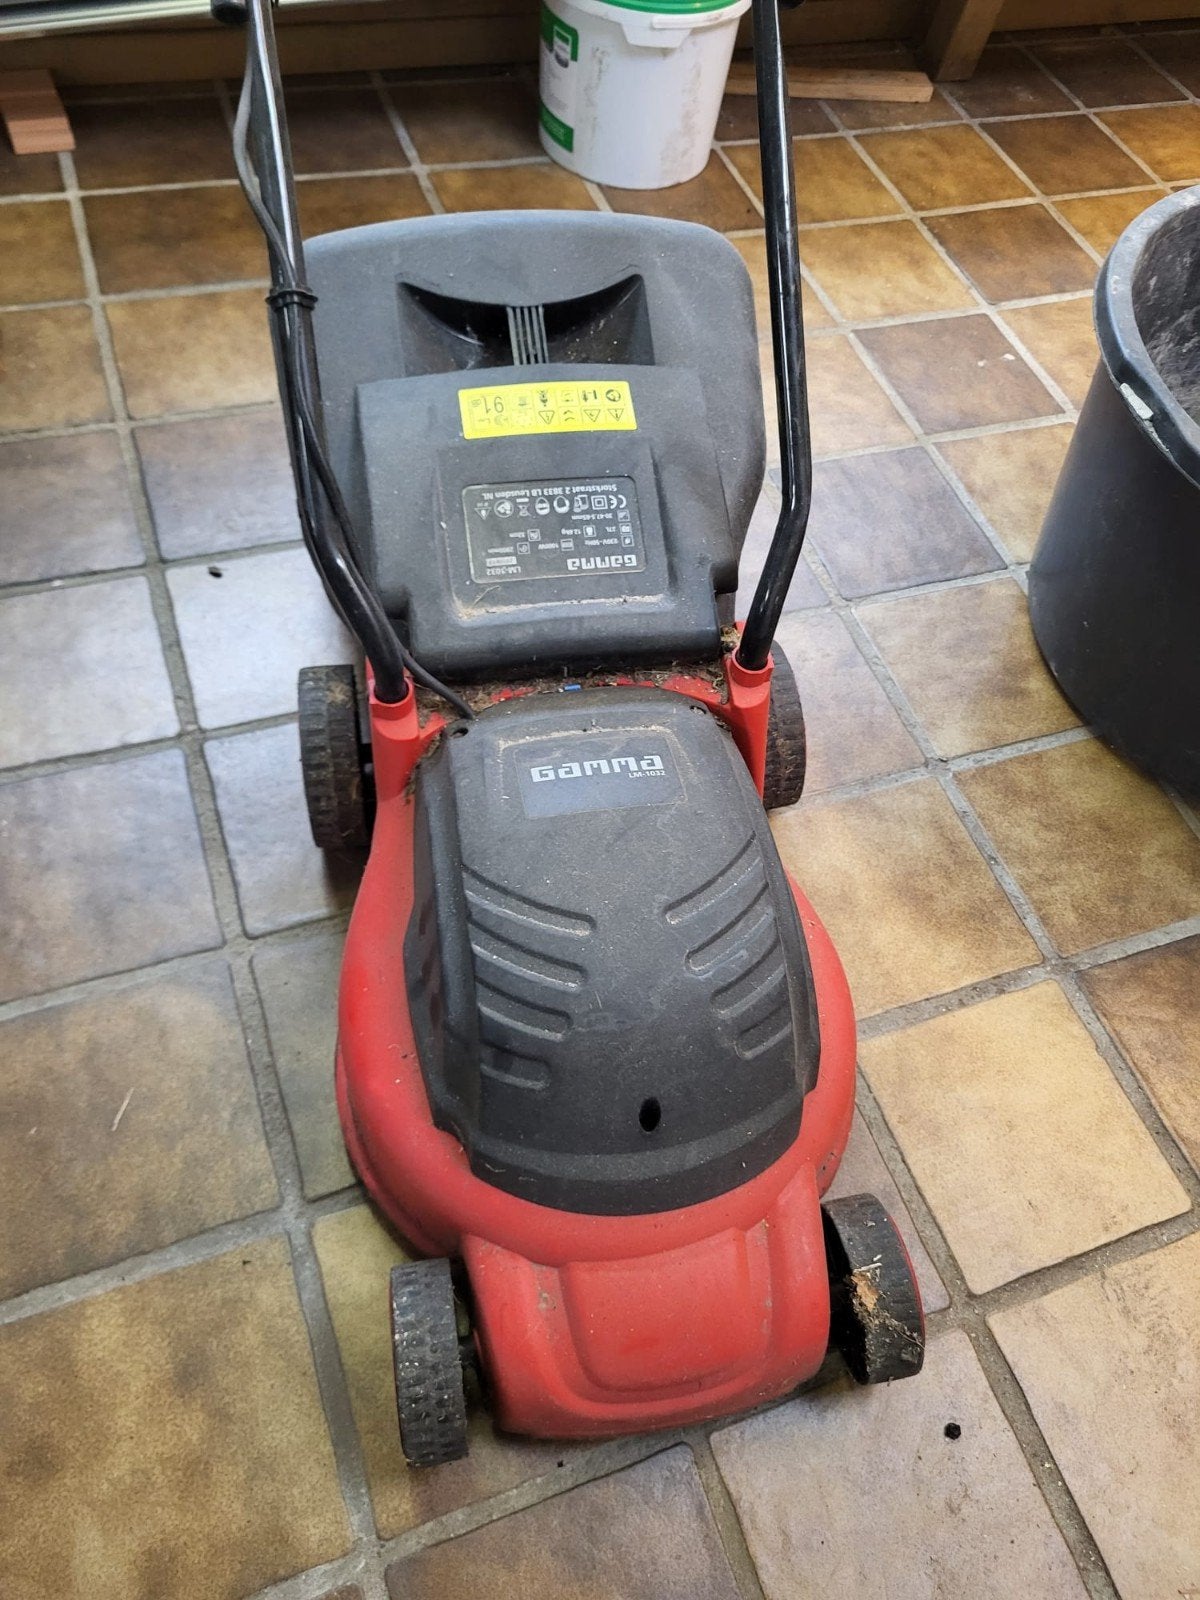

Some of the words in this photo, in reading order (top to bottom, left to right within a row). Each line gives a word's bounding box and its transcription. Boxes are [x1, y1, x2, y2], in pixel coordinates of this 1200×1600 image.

[481, 395, 505, 415] 91
[531, 488, 542, 497] LB
[565, 486, 570, 494] 2
[571, 484, 618, 493] Storkstraat
[481, 492, 494, 500] NL
[494, 489, 530, 498] Leusden
[628, 770, 666, 779] LM-1032
